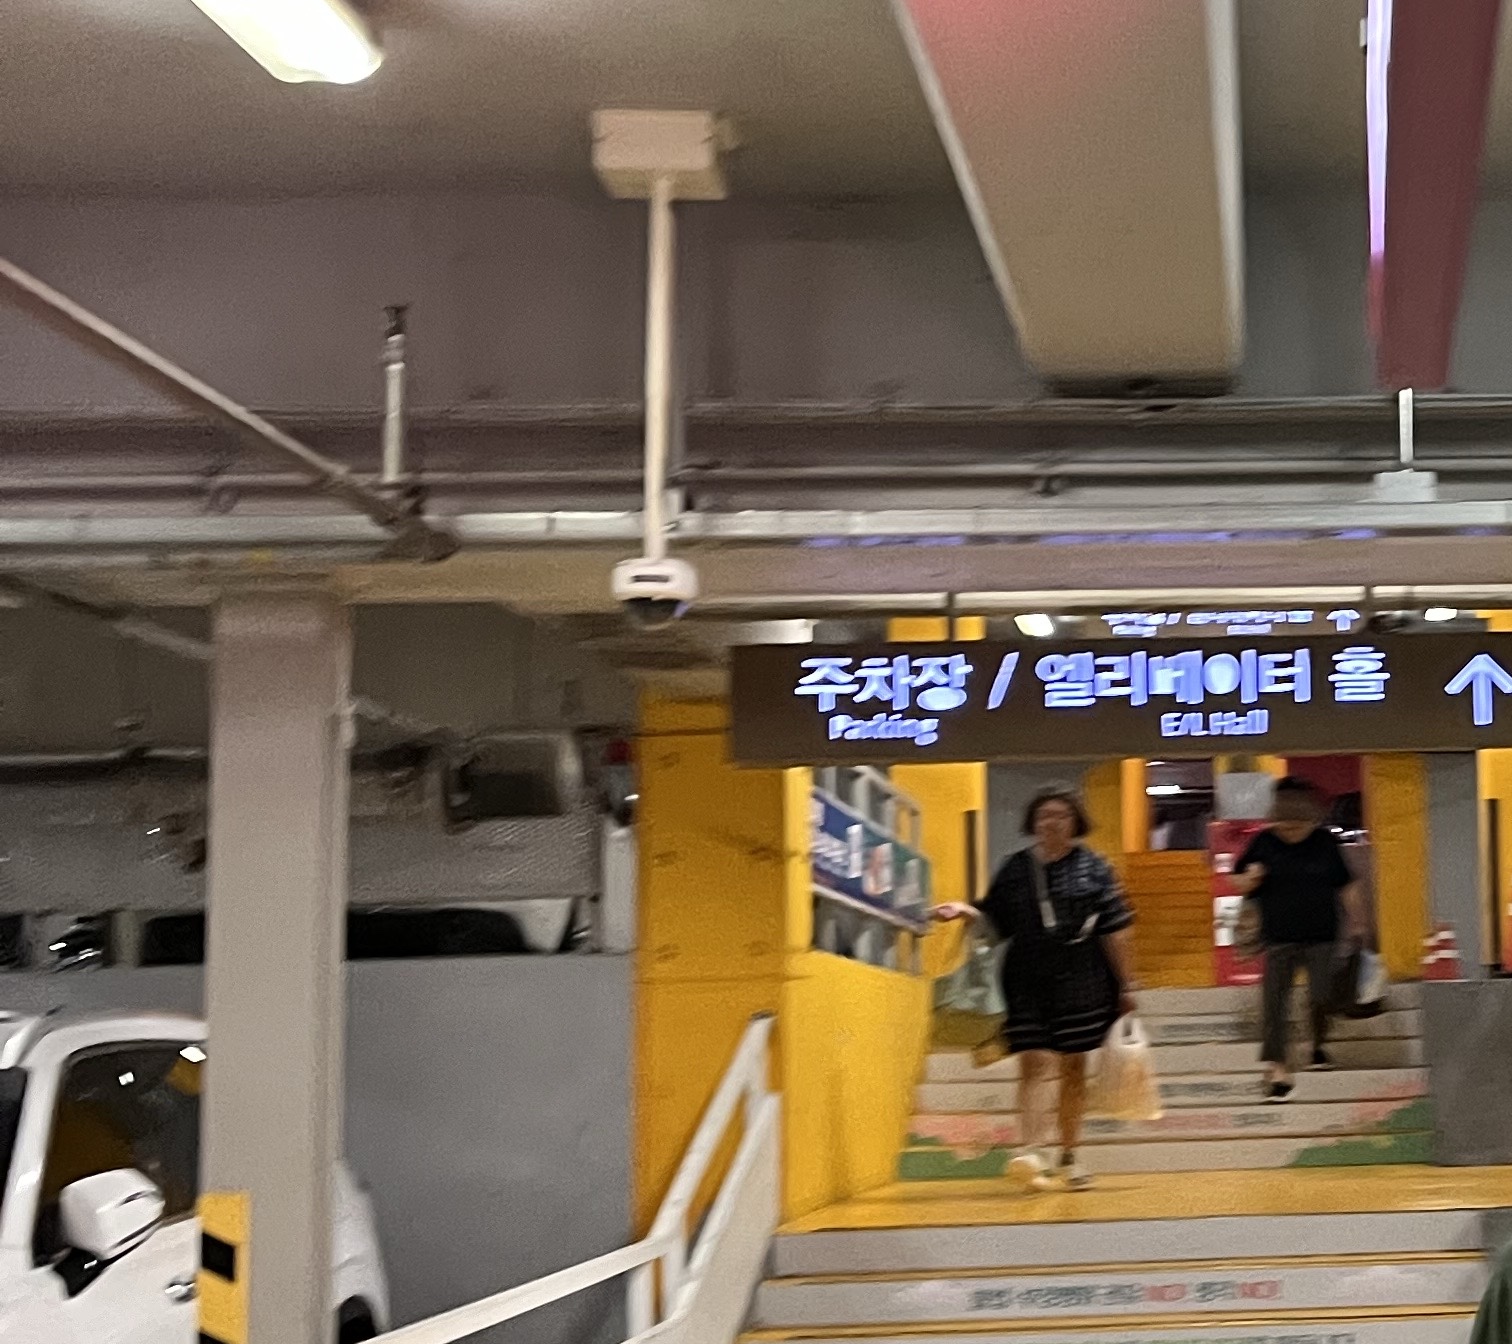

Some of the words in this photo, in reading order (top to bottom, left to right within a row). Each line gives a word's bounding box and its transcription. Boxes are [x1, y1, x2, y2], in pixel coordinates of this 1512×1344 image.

[794, 654, 973, 712] 주차장
[987, 651, 1020, 710] /
[1035, 648, 1311, 707] 엘리베이터
[1328, 646, 1391, 702] 홀
[829, 713, 939, 746] Parking
